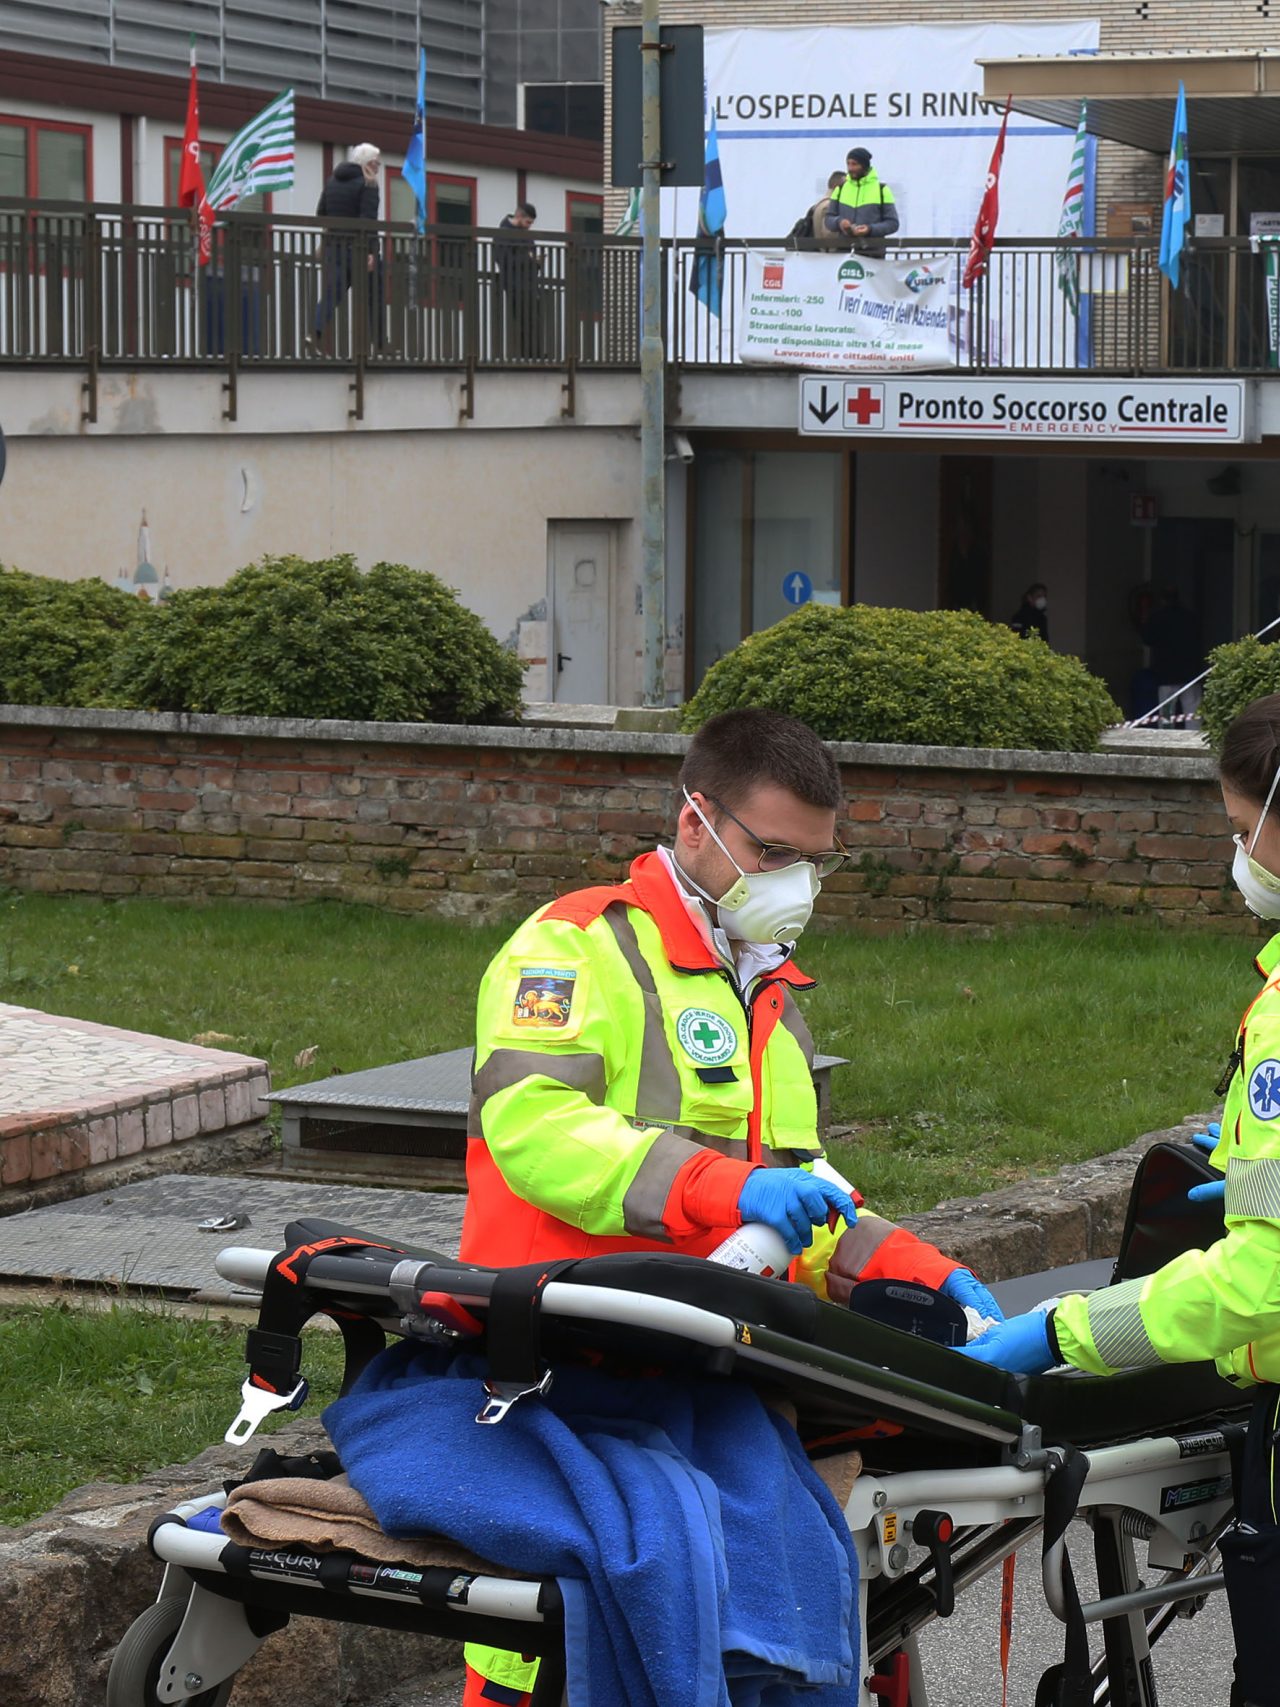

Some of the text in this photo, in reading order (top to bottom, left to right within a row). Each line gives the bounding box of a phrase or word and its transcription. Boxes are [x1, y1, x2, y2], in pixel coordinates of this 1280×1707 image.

[716, 93, 877, 120] L'OSPEDALE
[888, 92, 911, 118] SI
[840, 268, 863, 278] CISL
[781, 308, 803, 317] -100
[844, 294, 863, 312] veri
[861, 299, 896, 321] numeri
[749, 320, 812, 332] Straordinario
[747, 334, 779, 345] Pronte
[870, 340, 882, 349] 14
[774, 348, 830, 359] Lavoratori
[842, 351, 886, 361] cittadini
[889, 353, 915, 362] uniti
[899, 392, 1228, 423] Pronto Soccorso Centrale
[1009, 424, 1119, 434] EMERGENCY
